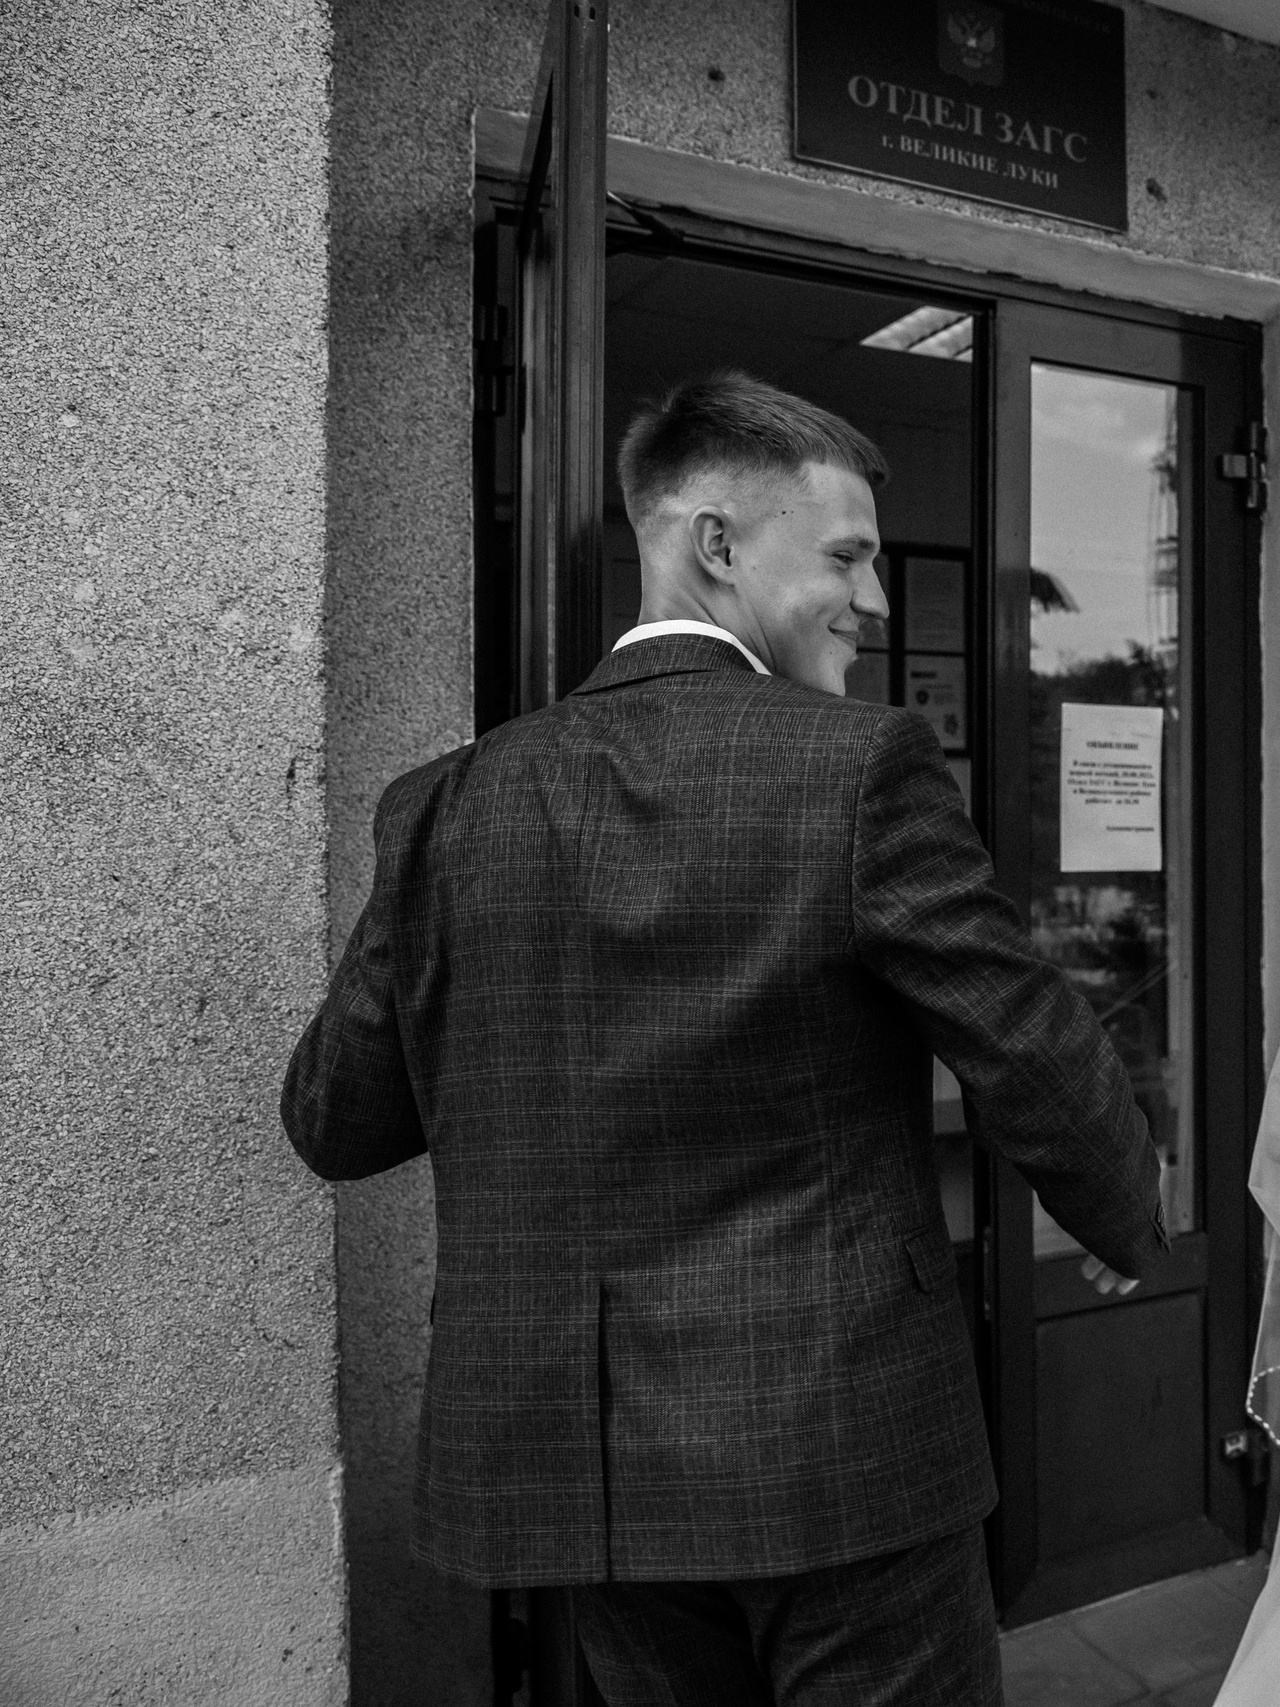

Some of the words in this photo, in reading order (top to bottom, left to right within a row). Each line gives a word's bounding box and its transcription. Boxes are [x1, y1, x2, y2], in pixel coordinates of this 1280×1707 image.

[847, 74, 983, 137] ОТДЕЛ
[995, 111, 1088, 163] ЗАГС
[900, 134, 999, 175] ВЕЛИКИЕ
[1002, 161, 1060, 190] ЛУКИ
